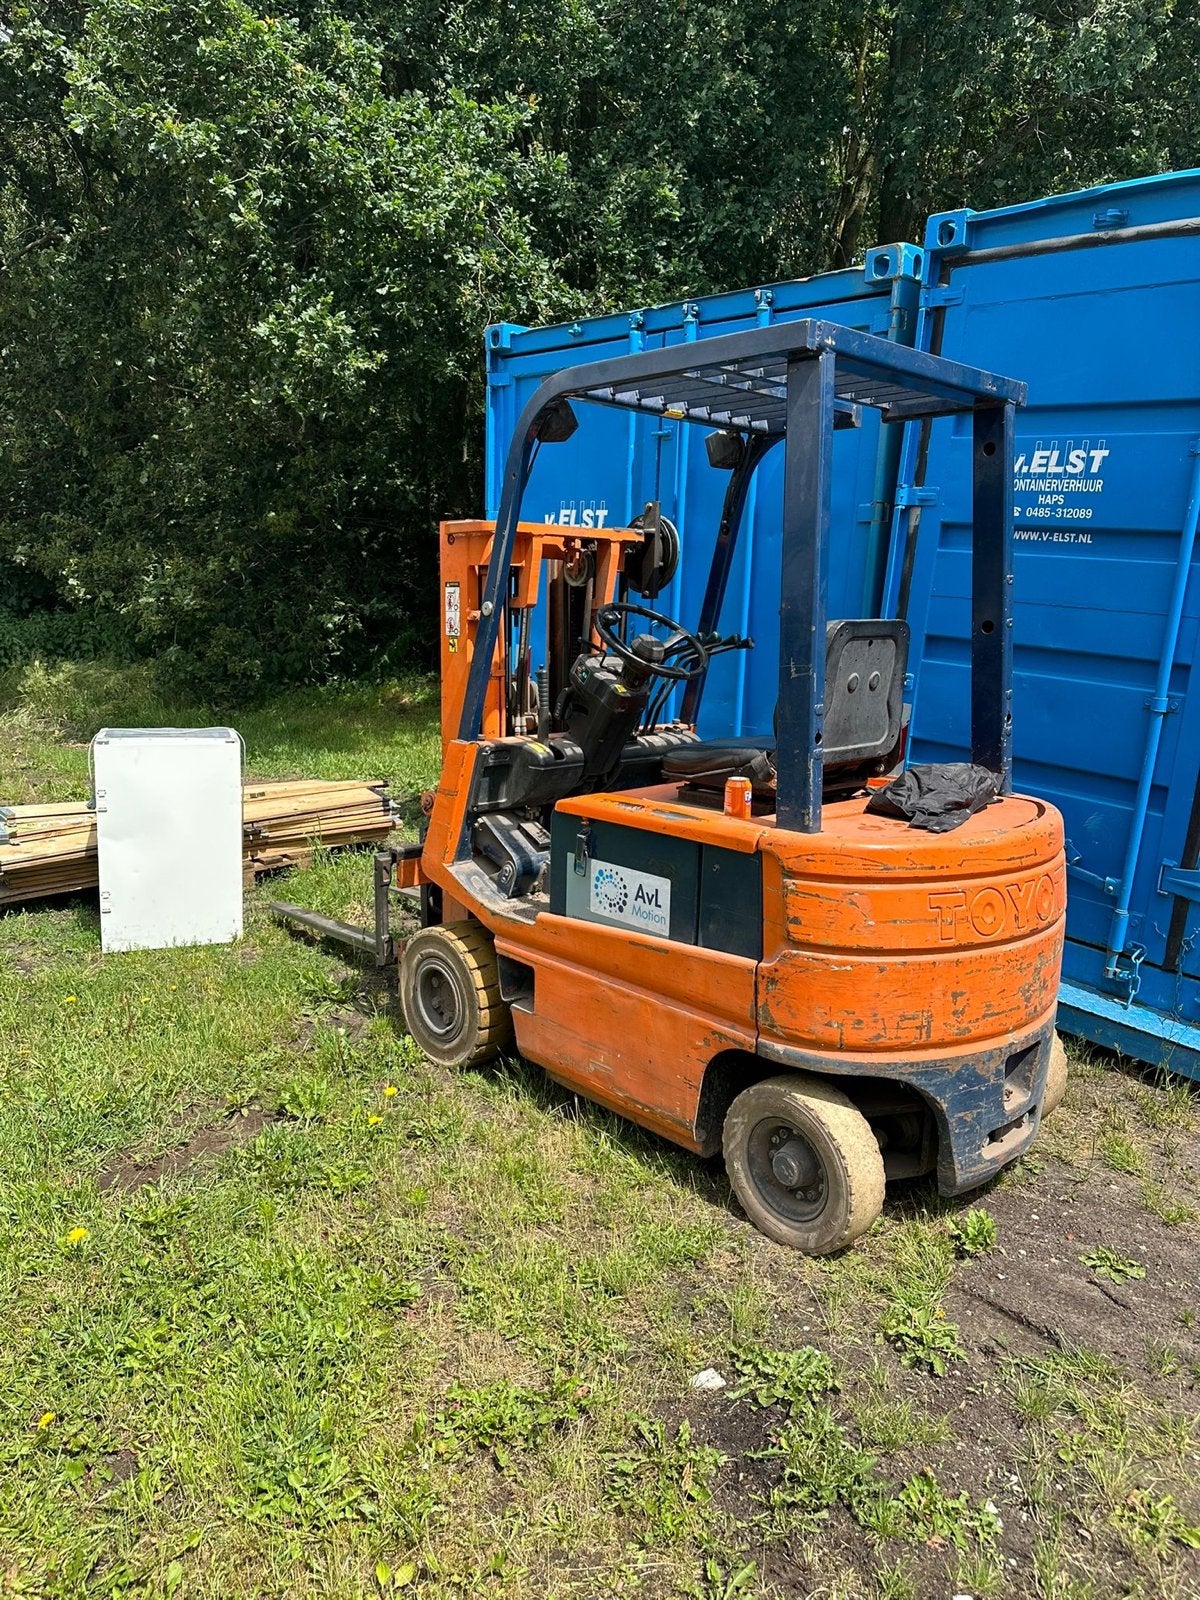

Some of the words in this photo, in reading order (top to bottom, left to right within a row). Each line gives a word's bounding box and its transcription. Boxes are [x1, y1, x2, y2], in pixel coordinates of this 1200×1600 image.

[1014, 479, 1103, 492] ONTAINERVERHUUR
[1038, 494, 1065, 505] HAPS
[1026, 507, 1093, 519] 0485-312089
[1014, 530, 1093, 544] WWW.V-ELST.NL
[634, 884, 662, 909] AvL
[631, 905, 667, 925] Motion
